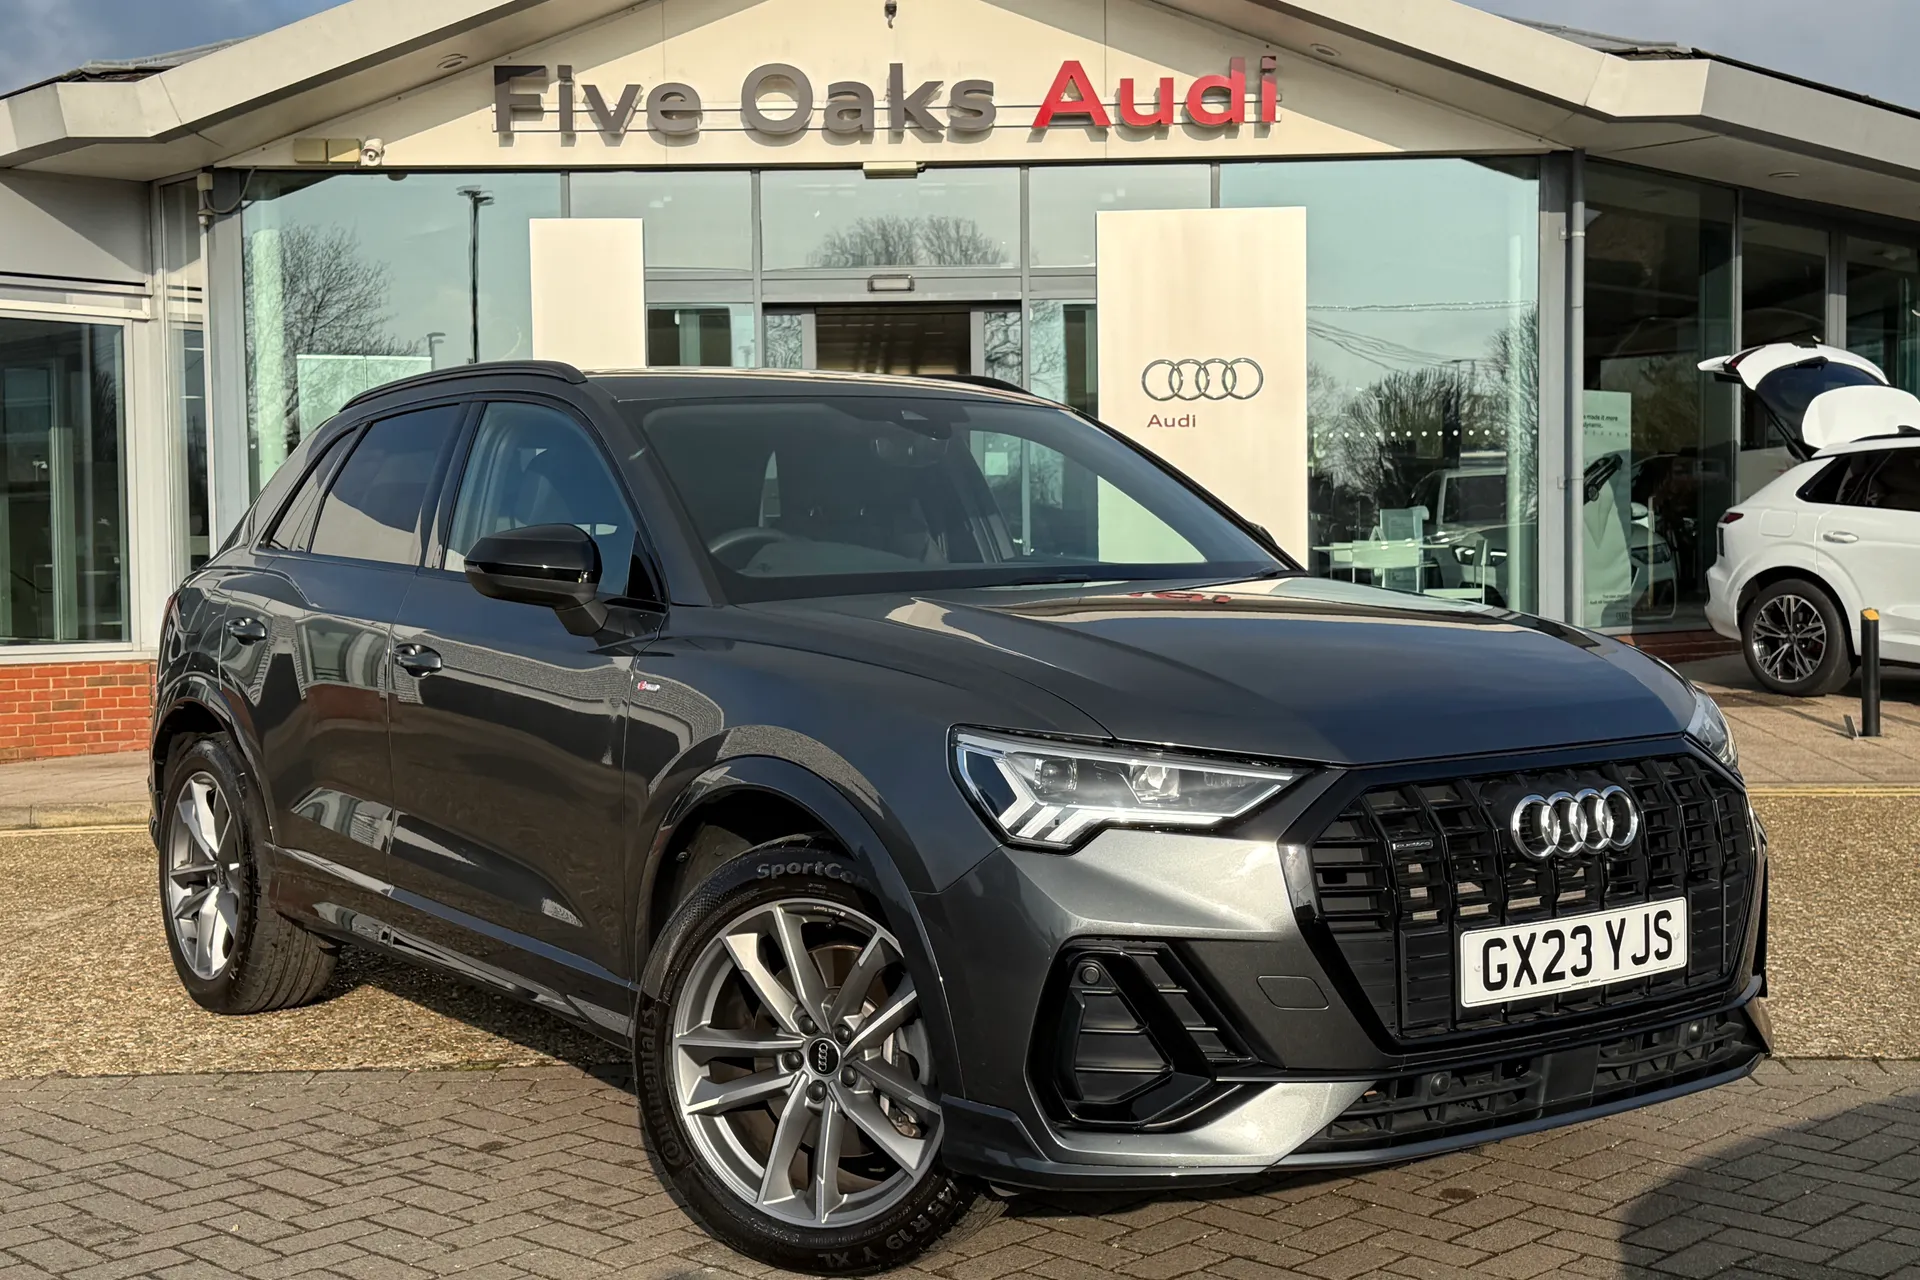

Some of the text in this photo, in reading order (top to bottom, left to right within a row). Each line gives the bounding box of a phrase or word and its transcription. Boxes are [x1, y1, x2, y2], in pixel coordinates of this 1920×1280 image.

[494, 55, 1278, 135] Five Oaks Audi
[1147, 413, 1196, 428] Audi
[1482, 909, 1673, 992] GX23 YJS
[910, 1213, 932, 1233] R
[886, 1229, 914, 1250] 19
[818, 1251, 850, 1268] XL
